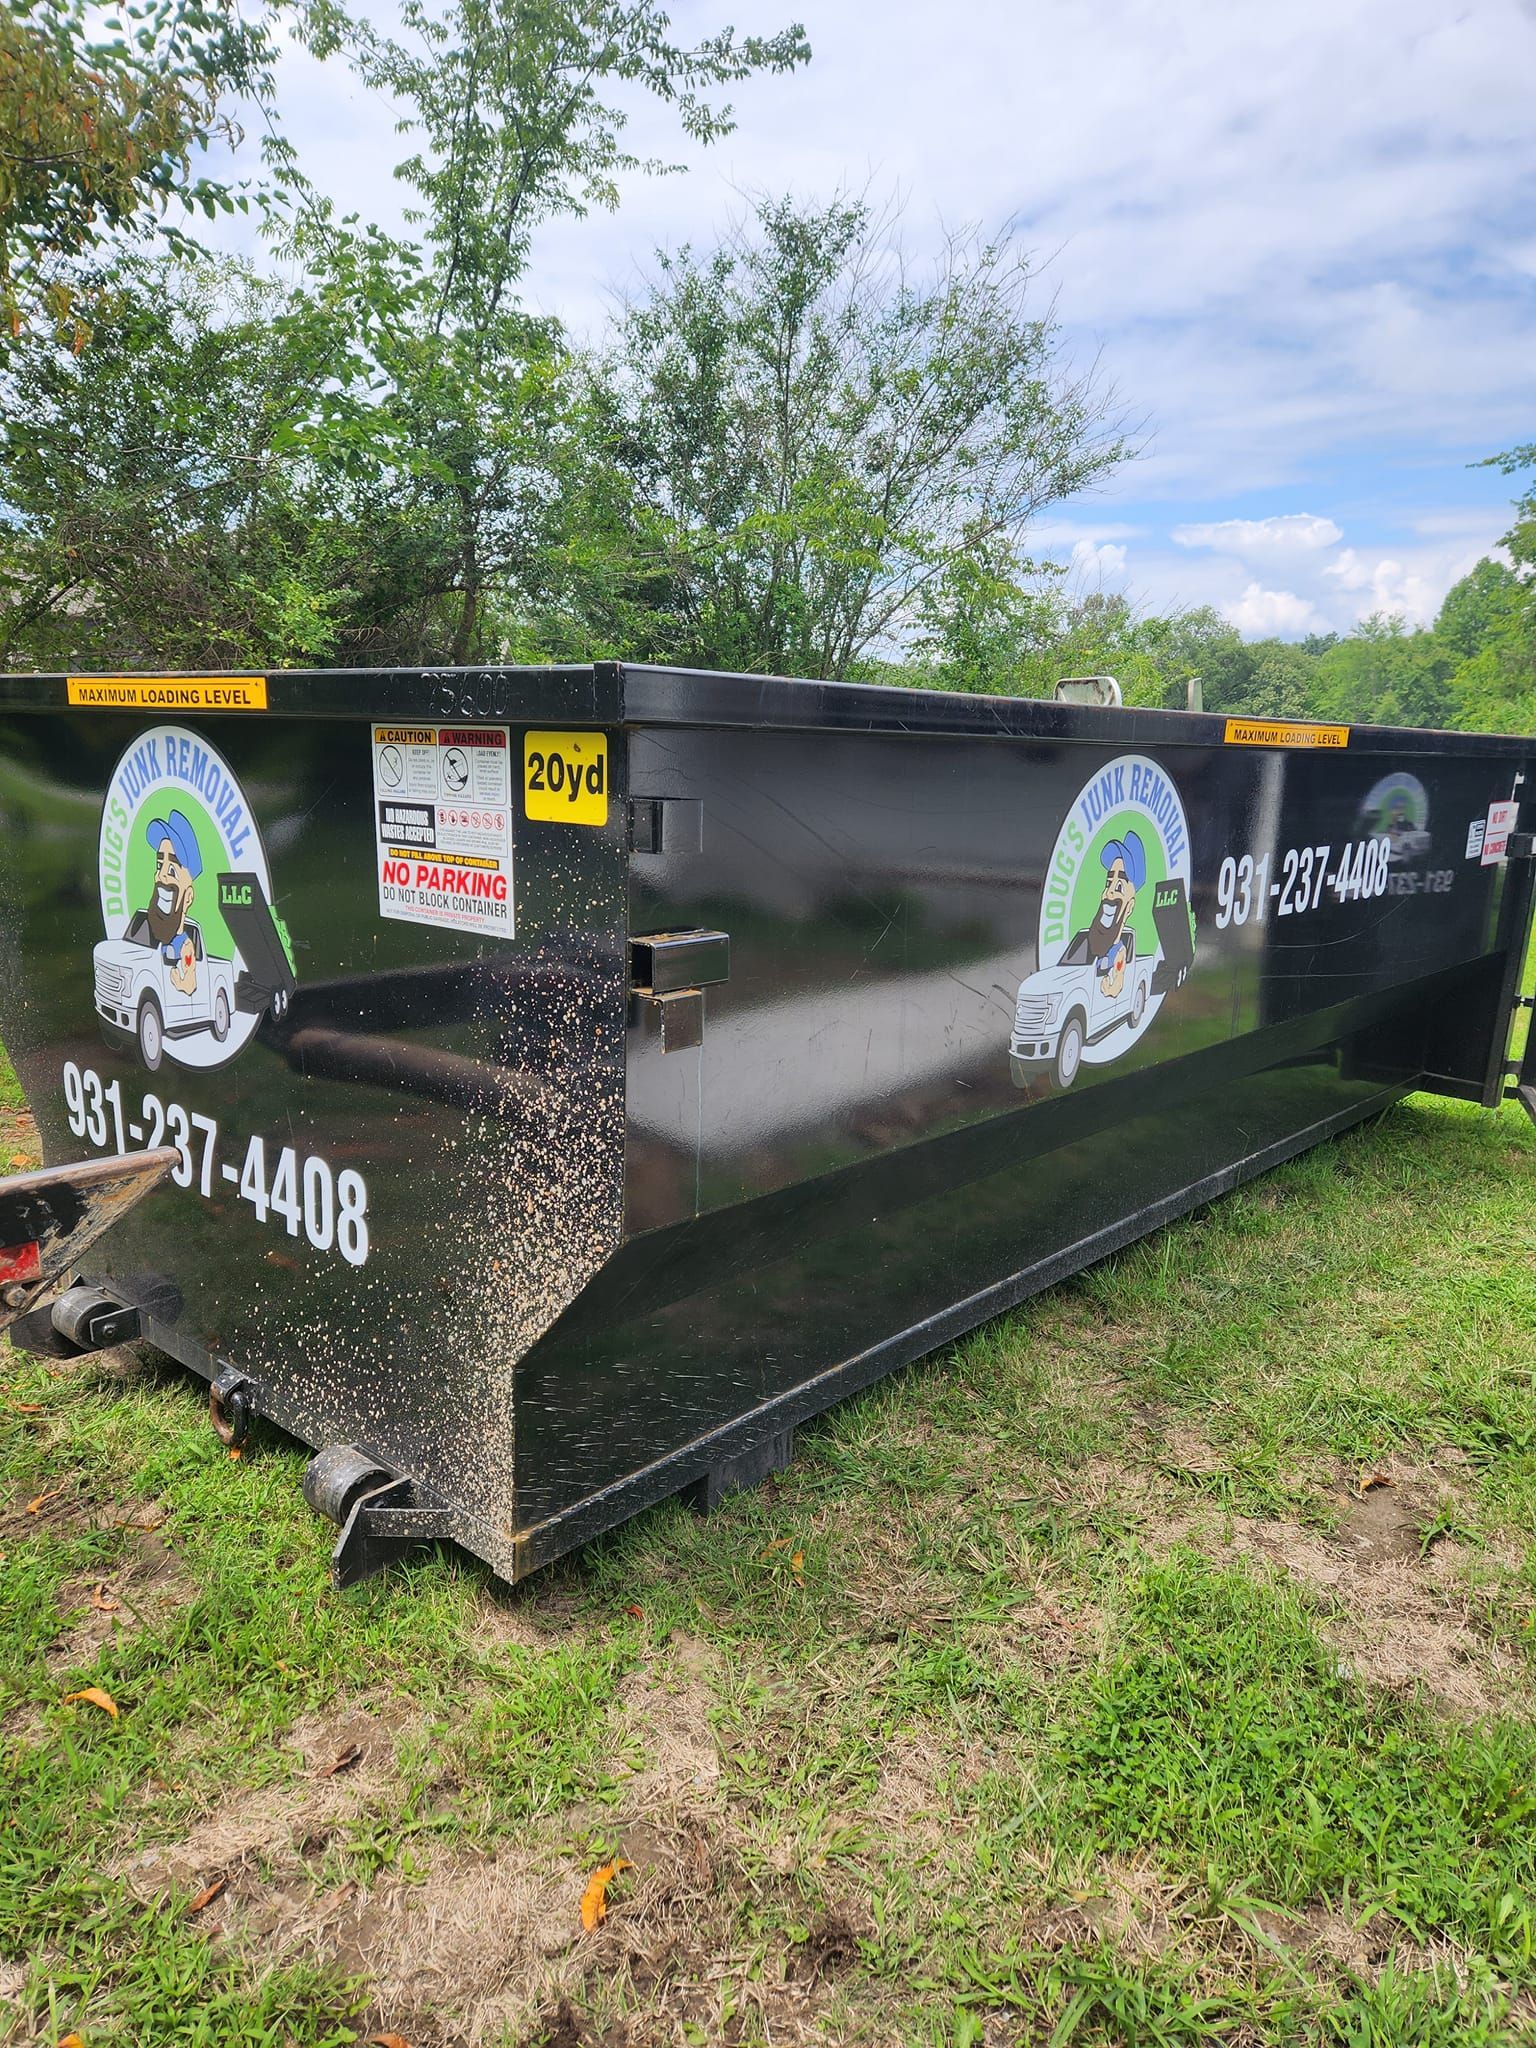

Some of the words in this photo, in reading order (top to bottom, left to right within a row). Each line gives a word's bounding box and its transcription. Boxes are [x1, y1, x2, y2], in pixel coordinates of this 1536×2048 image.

[79, 688, 137, 703] MAXIMUM
[141, 689, 200, 704] LOADING
[205, 690, 251, 704] LEVEL
[387, 730, 432, 743] CAUTION
[452, 732, 502, 745] WARNING
[1234, 729, 1278, 743] MAXIMUM
[1280, 732, 1316, 744] LOADING
[1317, 734, 1341, 745] LEVEL
[528, 752, 604, 802] 20yd
[104, 797, 128, 917] DOUG'S
[118, 738, 162, 809] JUNK
[165, 735, 251, 860] REMOVAL
[385, 807, 394, 823] NO
[395, 808, 429, 826] HAZARDOUS
[381, 823, 404, 840] WASTES
[405, 824, 434, 843] ACCEPTED
[399, 849, 410, 857] NOT
[411, 850, 423, 859] FILL
[424, 852, 442, 861] ABOVE
[443, 854, 455, 863] TOP
[456, 856, 464, 864] OF
[1044, 821, 1085, 946] DOUG'S
[1080, 765, 1125, 832] JUNK
[1129, 763, 1186, 869] REMOVAL
[383, 861, 410, 886] NO
[415, 865, 507, 901] PARKING
[1215, 837, 1391, 929] 931-237-4408
[221, 885, 252, 905] LLC
[383, 887, 395, 900] DO
[398, 888, 416, 905] NOT
[420, 891, 450, 909] BLOCK
[452, 896, 508, 919] CONTAINER
[1156, 889, 1179, 908] LLC
[63, 1061, 369, 1266] 931-237-4408
